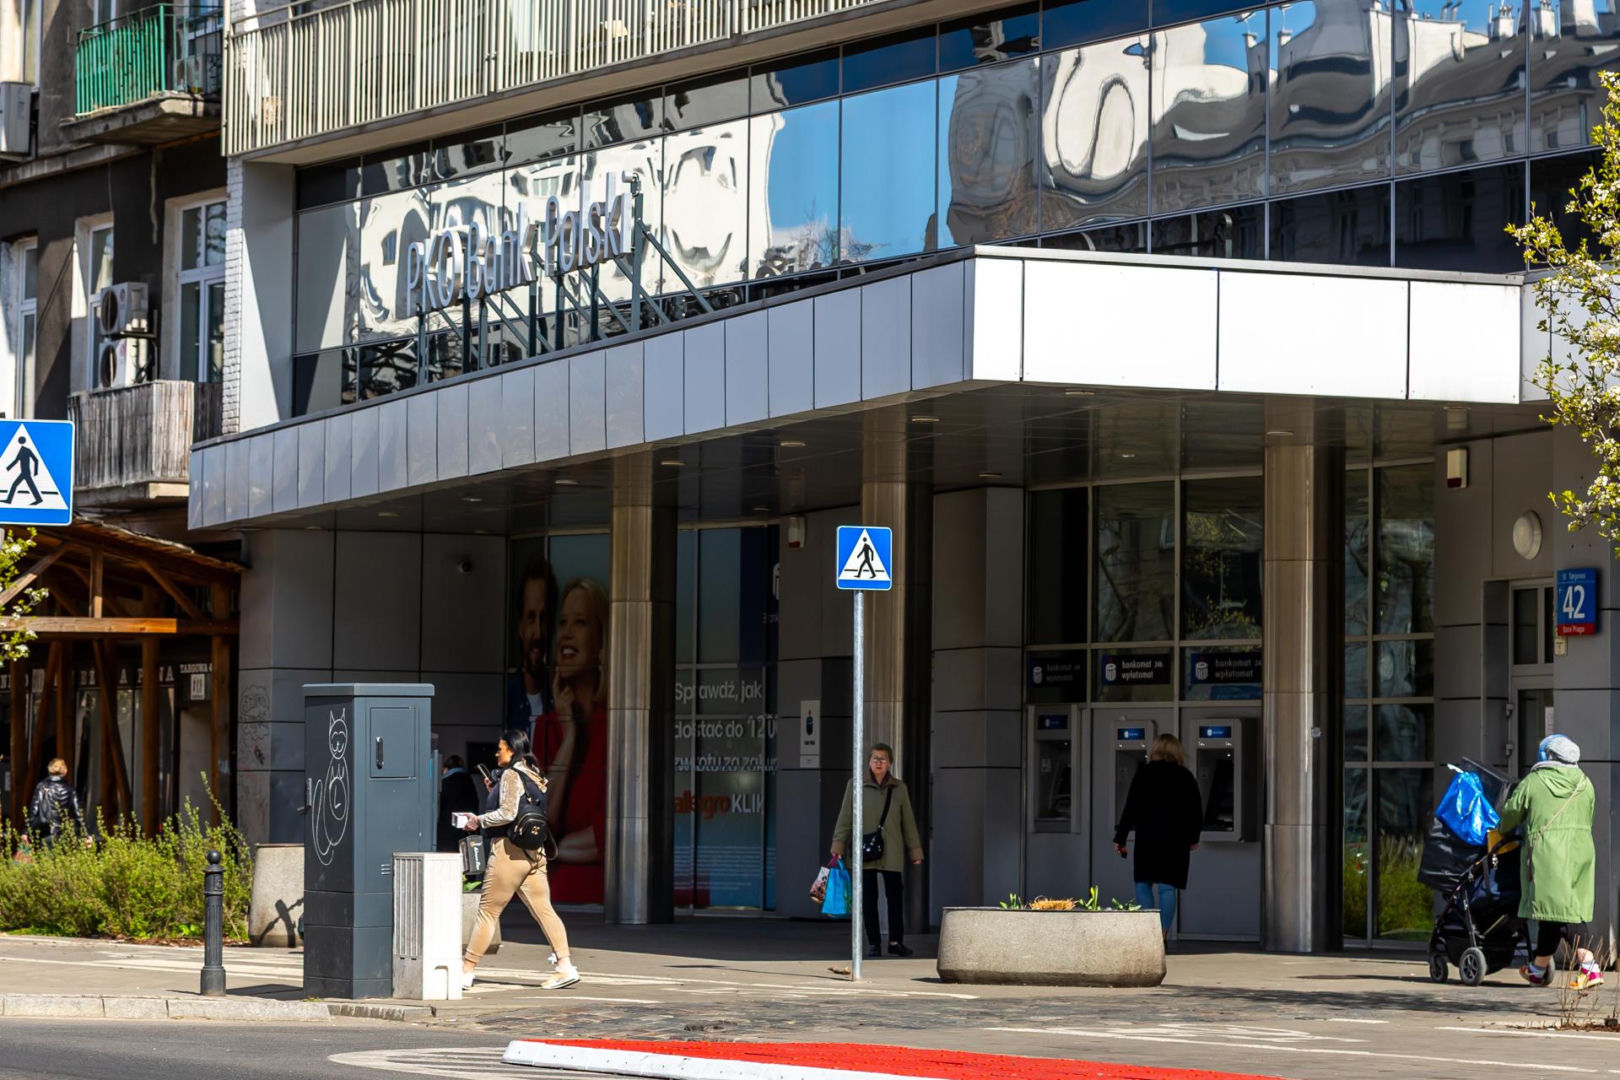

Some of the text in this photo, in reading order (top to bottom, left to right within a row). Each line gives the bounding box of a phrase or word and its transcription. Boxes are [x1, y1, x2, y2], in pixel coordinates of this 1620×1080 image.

[406, 170, 633, 317] PKO Bank Polski
[1563, 585, 1585, 619] 42
[740, 680, 763, 704] jak
[725, 720, 744, 738] do
